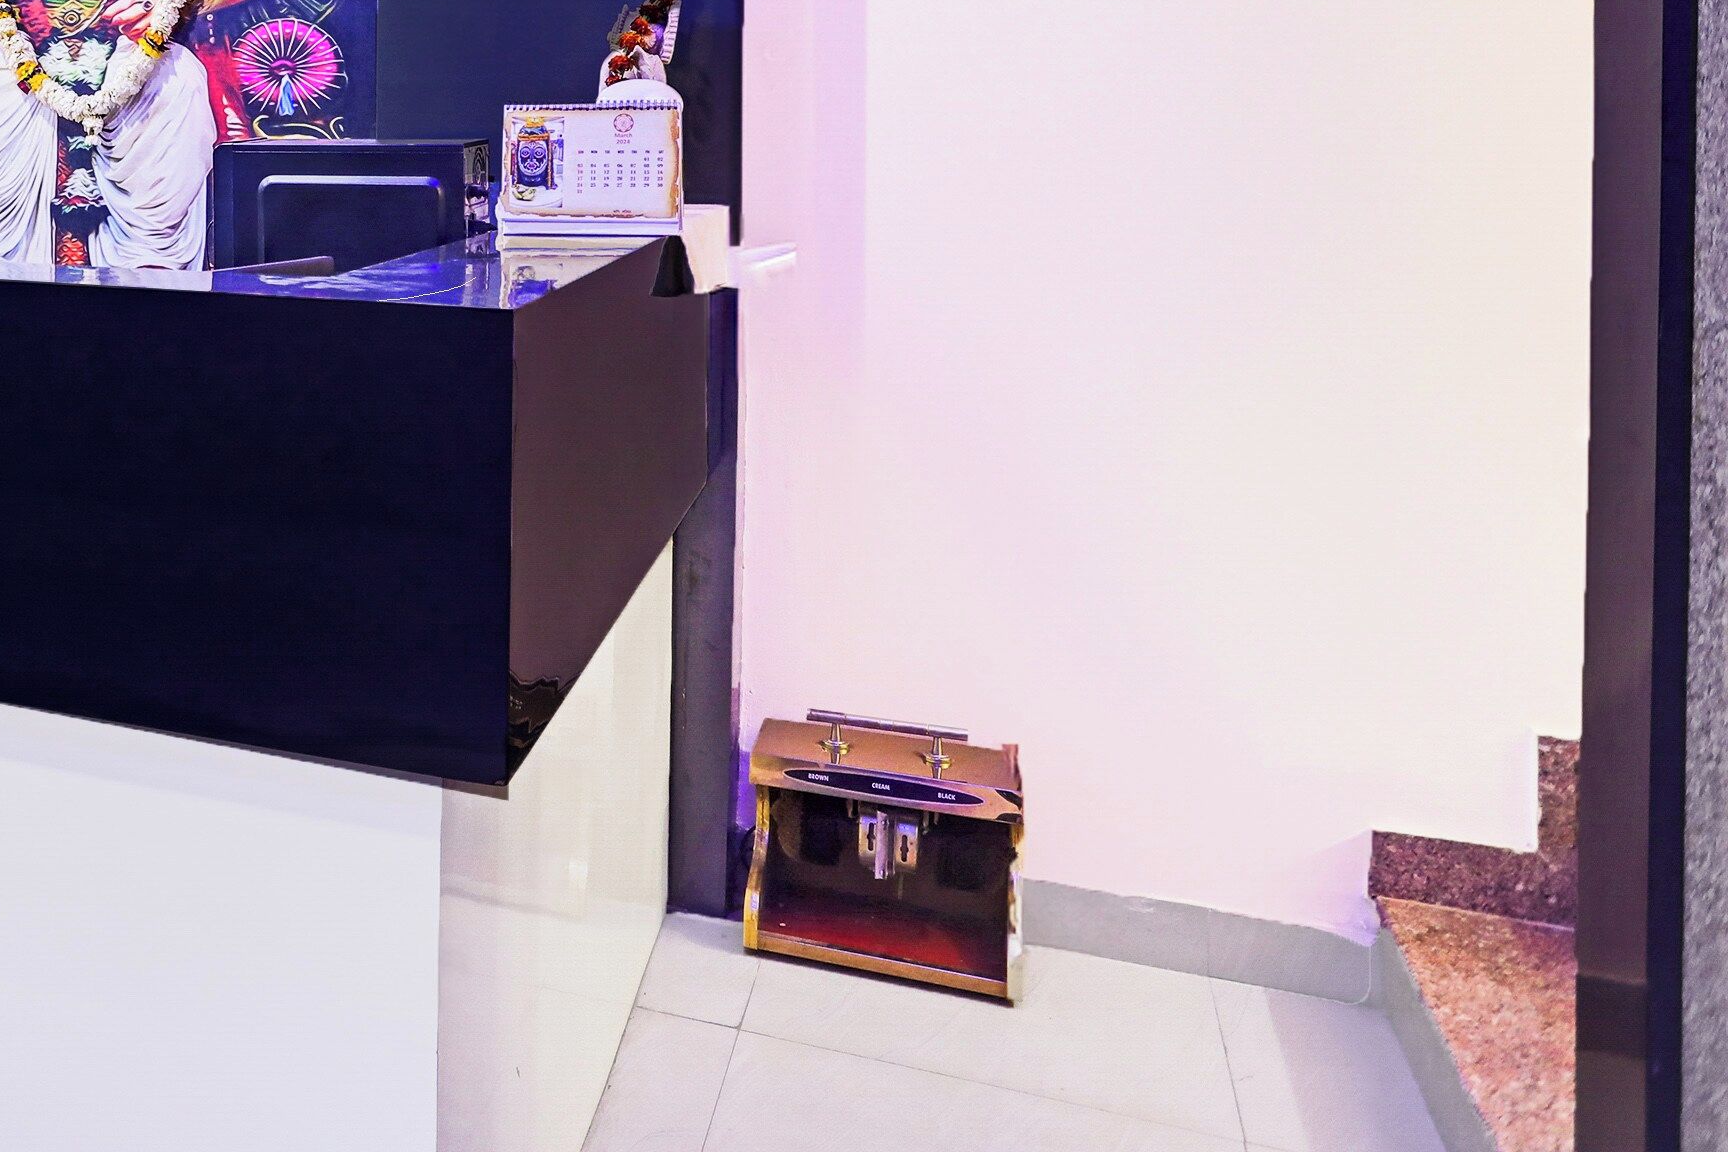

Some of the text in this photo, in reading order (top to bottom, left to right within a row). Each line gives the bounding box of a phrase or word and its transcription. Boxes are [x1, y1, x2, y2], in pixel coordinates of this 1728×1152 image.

[808, 772, 829, 782] BROWN
[872, 782, 890, 791] CREAM
[937, 792, 956, 801] BLACK
